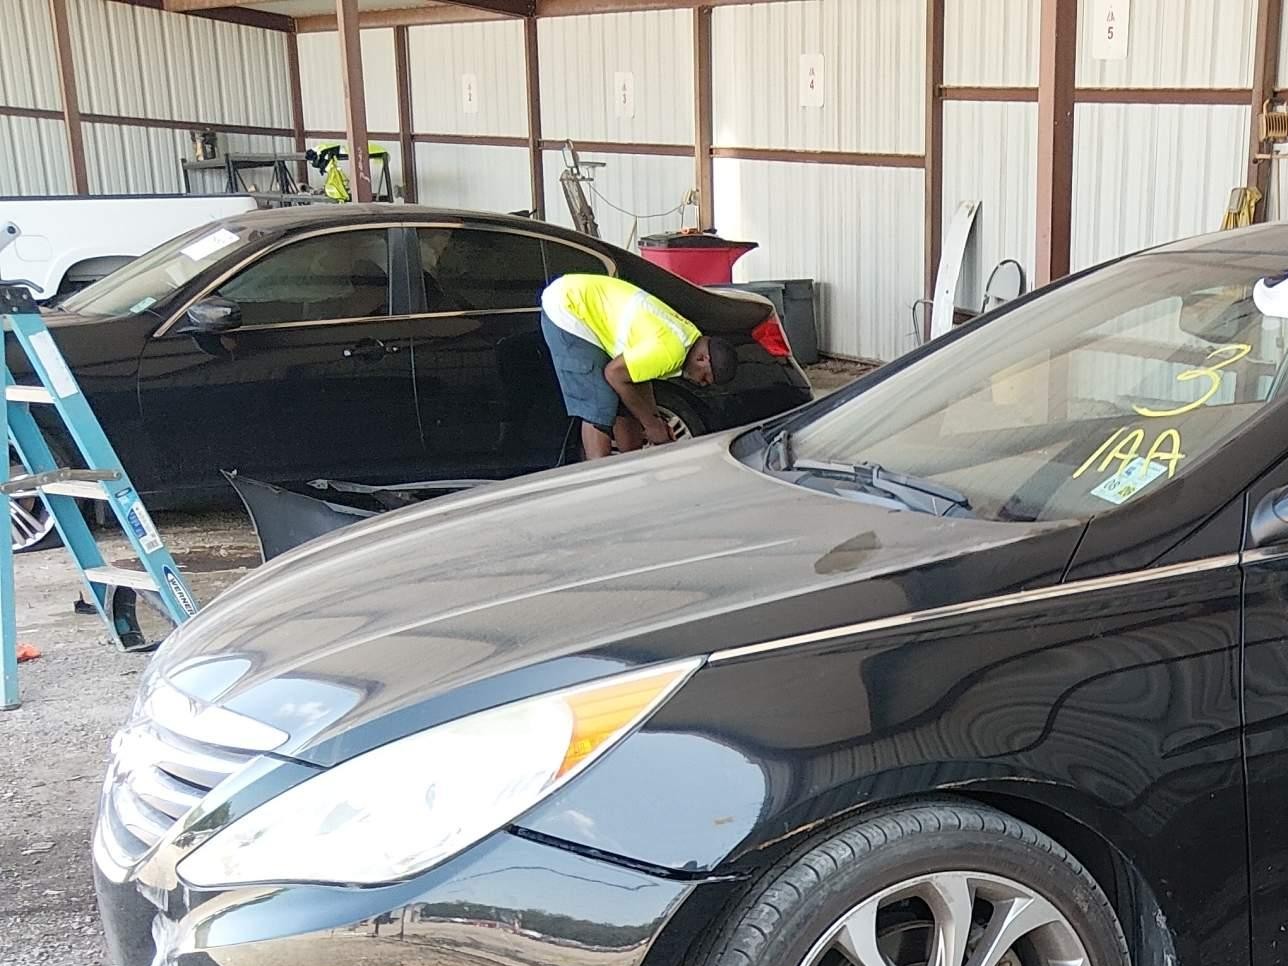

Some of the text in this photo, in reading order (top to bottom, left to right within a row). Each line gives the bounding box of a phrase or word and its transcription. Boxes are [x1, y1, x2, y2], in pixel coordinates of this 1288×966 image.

[1107, 26, 1114, 40] 5
[809, 79, 815, 91] 4
[1132, 344, 1253, 417] 3
[1072, 427, 1186, 480] IAA
[169, 577, 195, 616] WERNER
